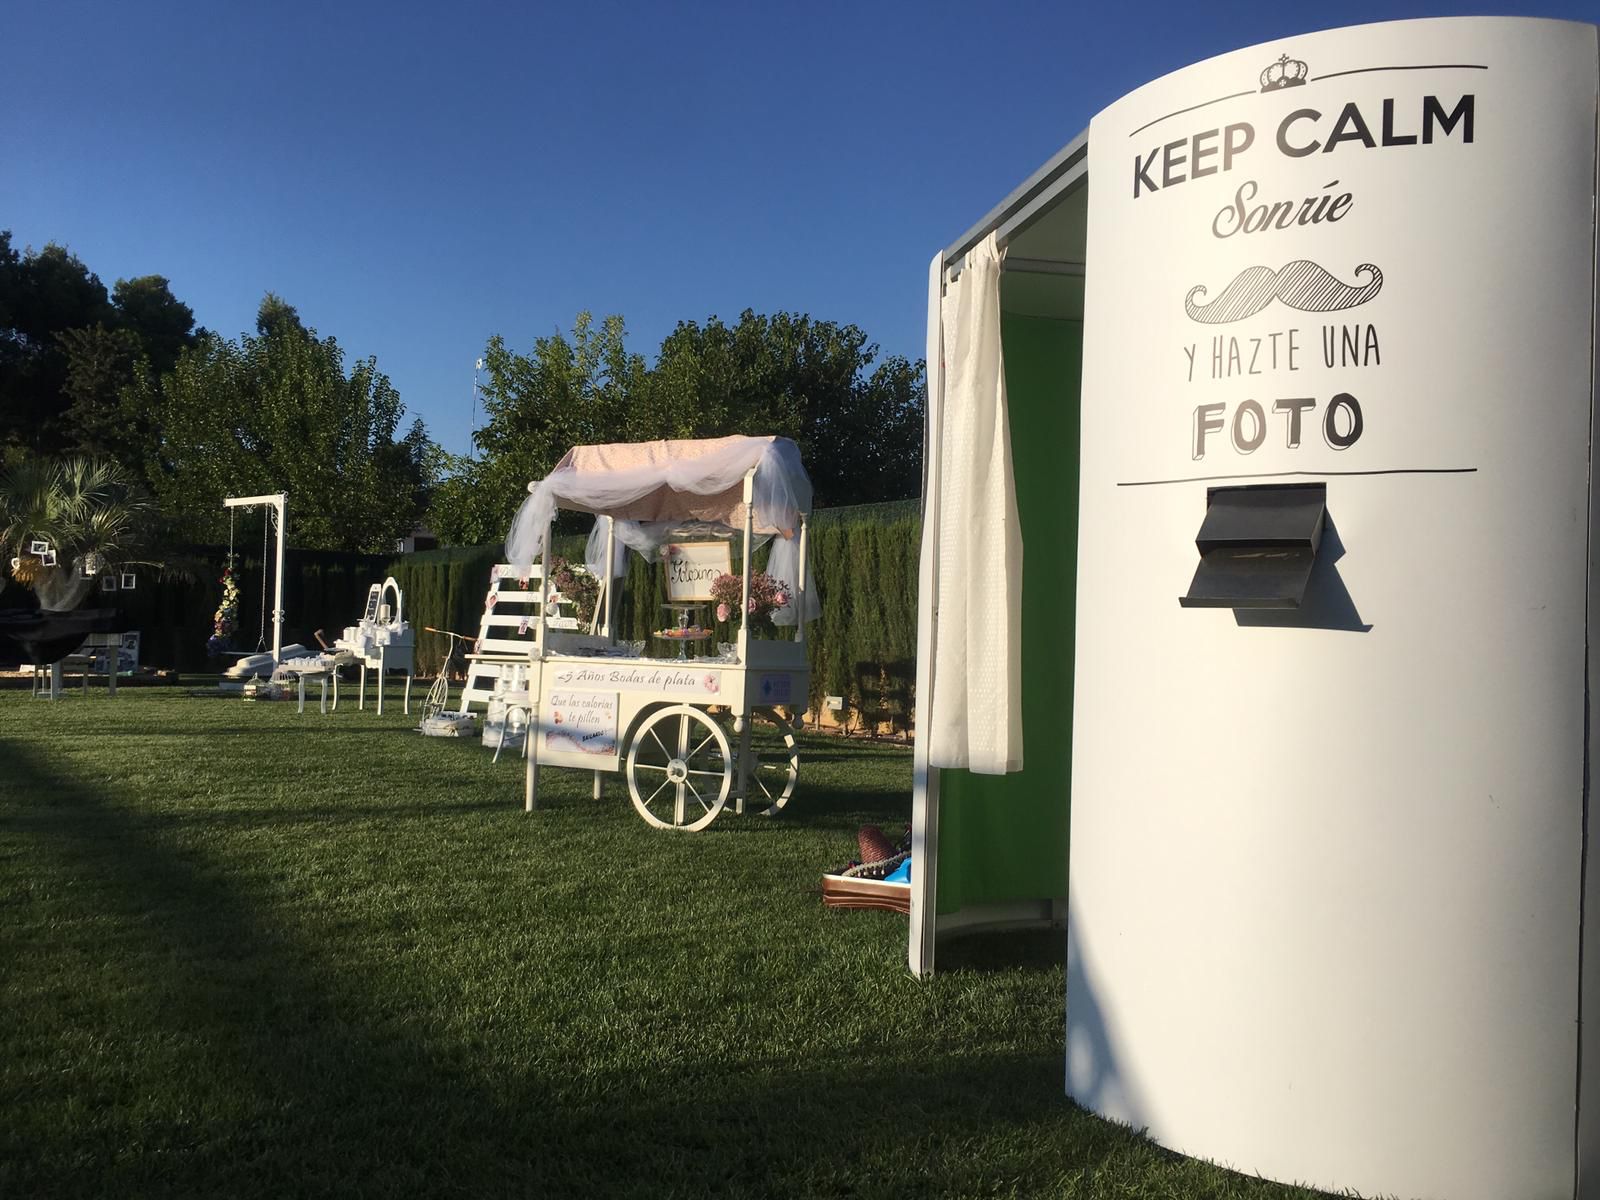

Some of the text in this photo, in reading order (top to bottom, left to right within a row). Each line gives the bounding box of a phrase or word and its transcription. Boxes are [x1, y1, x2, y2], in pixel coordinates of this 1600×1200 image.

[1133, 94, 1475, 199] KEEP CALM
[1211, 180, 1353, 239] Sonríe
[1183, 323, 1380, 382] Y HAZTE UNA
[1192, 392, 1364, 461] FOTO
[551, 695, 567, 706] Que
[569, 694, 581, 708] las
[577, 669, 606, 682] Años
[609, 669, 645, 684] Bodas
[648, 670, 662, 685] de
[664, 671, 696, 690] plata
